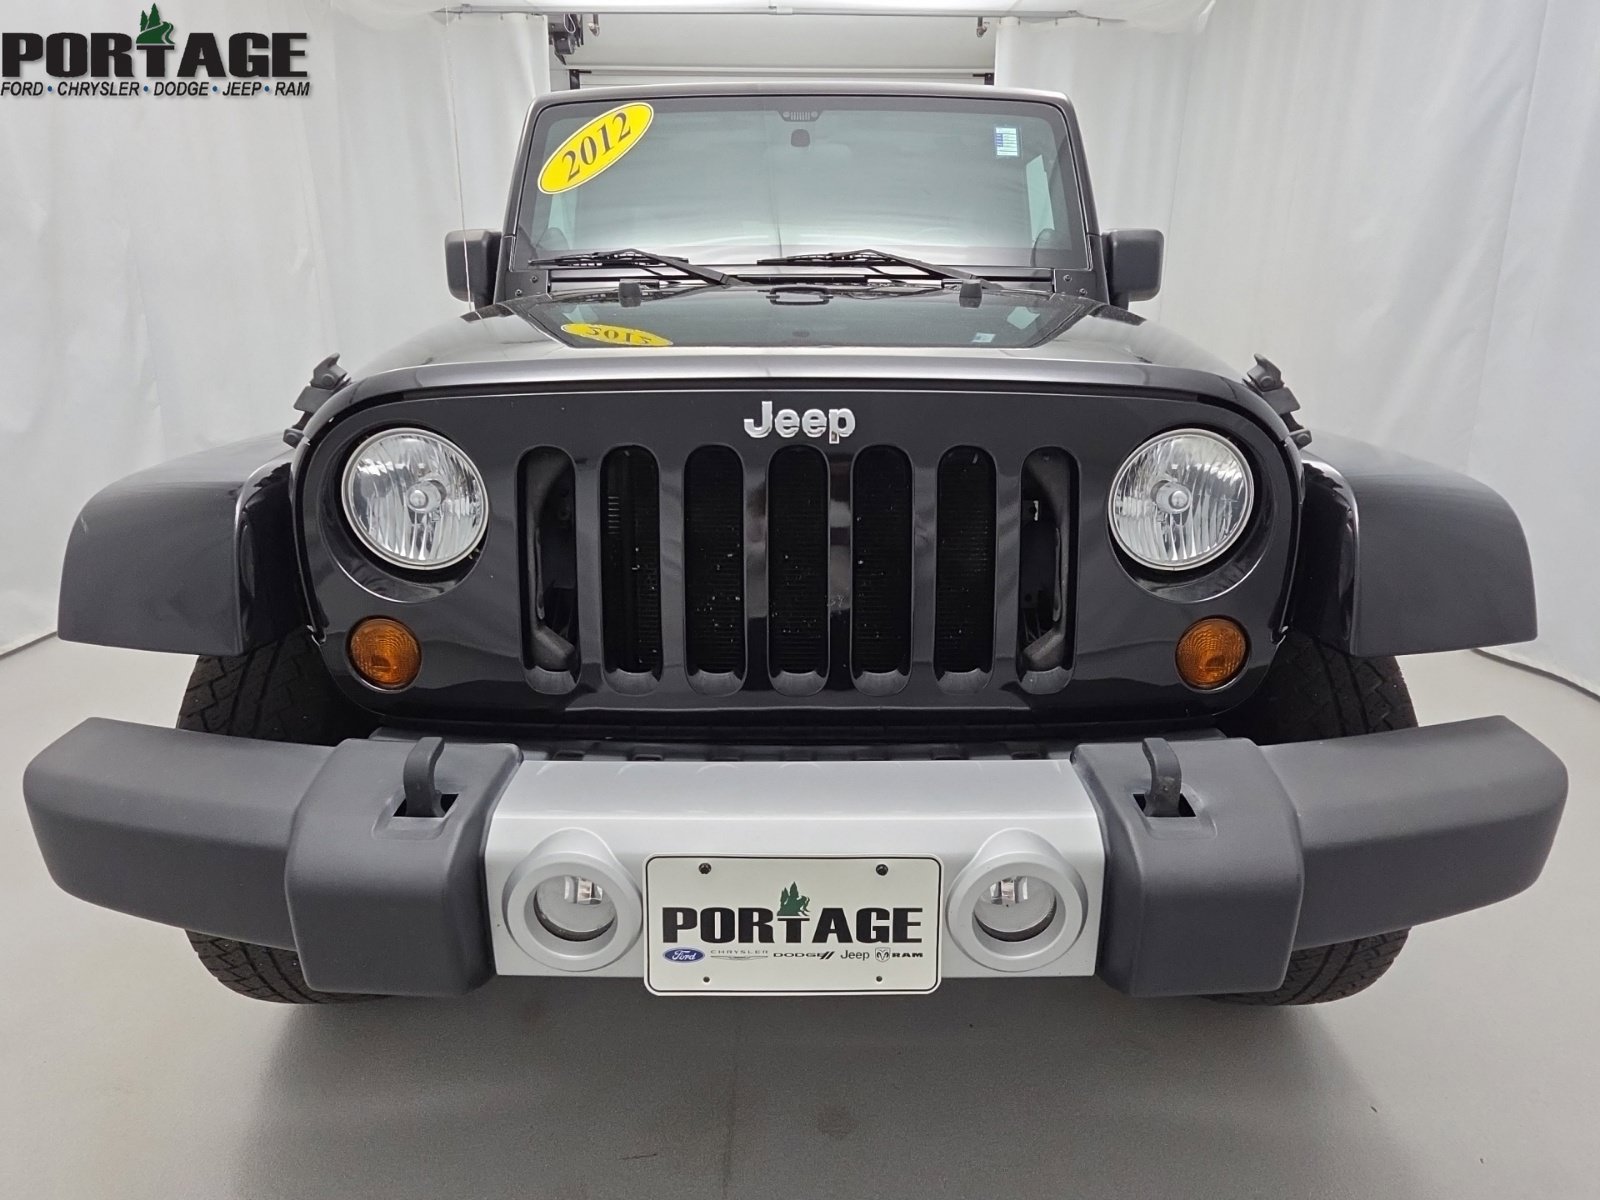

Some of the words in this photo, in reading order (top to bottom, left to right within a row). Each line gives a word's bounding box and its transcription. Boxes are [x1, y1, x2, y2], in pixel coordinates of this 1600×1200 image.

[561, 111, 632, 183] 2012
[743, 400, 856, 444] Jeep
[662, 907, 923, 944] PORTAGE
[840, 949, 871, 961] Jeep
